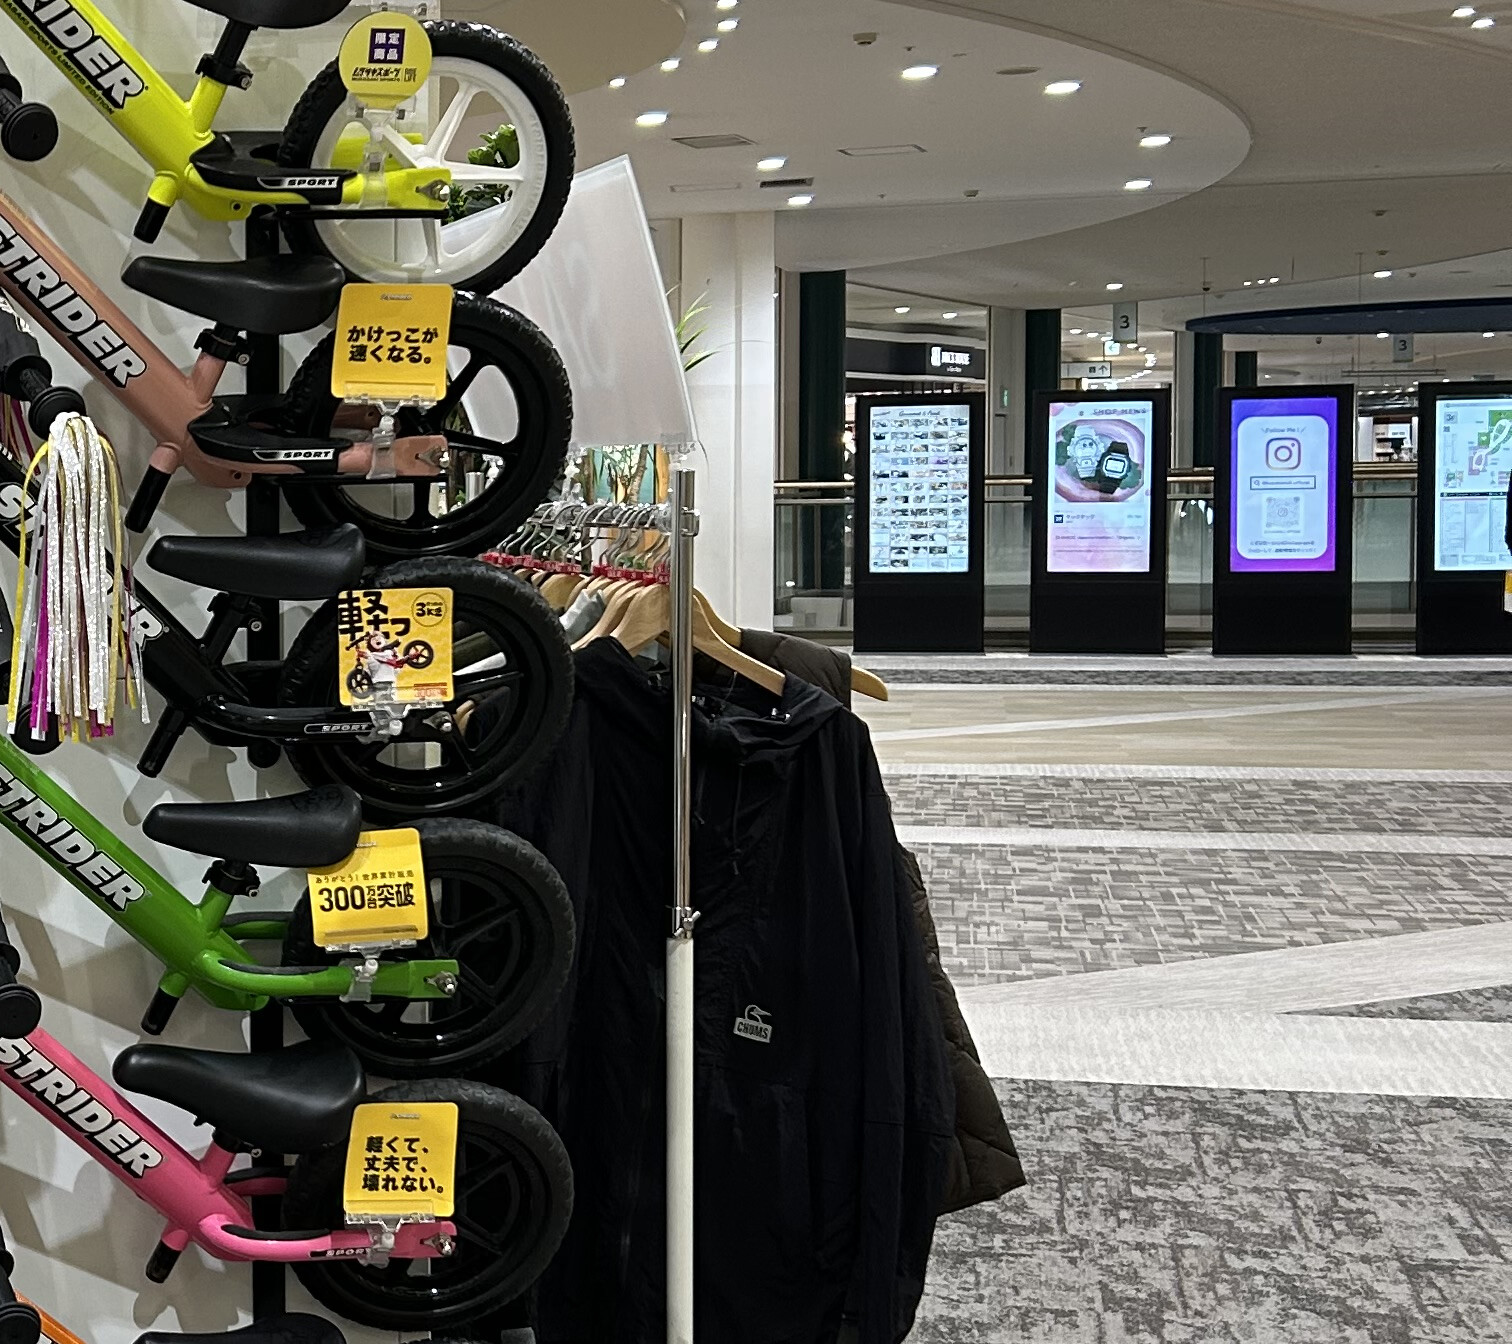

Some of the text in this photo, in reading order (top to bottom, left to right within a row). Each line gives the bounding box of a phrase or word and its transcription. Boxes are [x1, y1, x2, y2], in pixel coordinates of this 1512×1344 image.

[375, 32, 400, 45] 限定
[374, 48, 398, 60] 商品
[29, 23, 59, 58] SPORTS
[55, 54, 88, 86] LIMITED
[85, 83, 115, 115] EDITION
[288, 177, 335, 187] SPORT
[346, 325, 439, 344] かけっこが
[348, 344, 432, 364] 速くなる。
[282, 450, 332, 460] SPORT
[318, 881, 416, 912] 300万台突破
[365, 1135, 430, 1154] 軽くて、
[364, 1155, 429, 1173] 丈夫で、
[361, 1174, 444, 1194] 壊れない。
